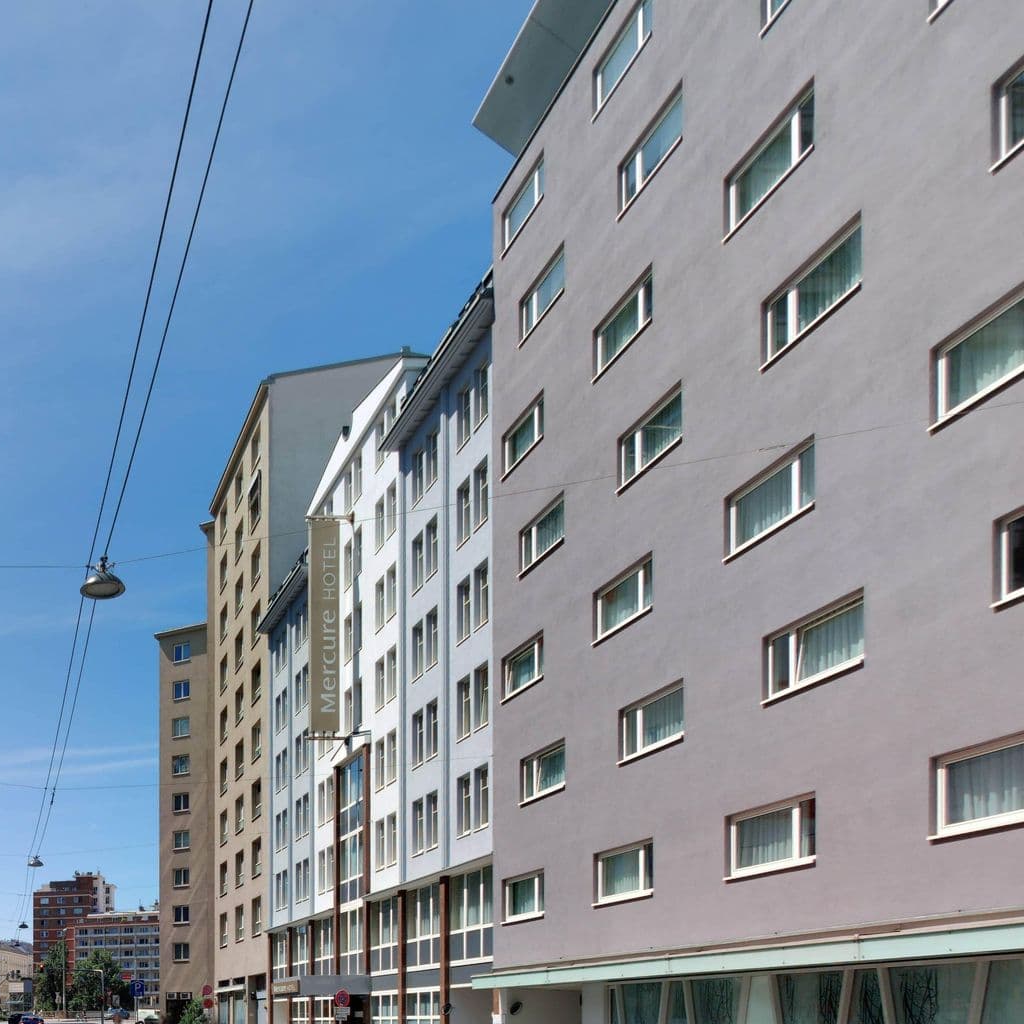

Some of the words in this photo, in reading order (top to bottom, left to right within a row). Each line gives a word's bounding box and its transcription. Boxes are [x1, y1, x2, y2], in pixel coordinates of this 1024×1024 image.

[323, 536, 337, 600] HOTEL
[320, 609, 337, 713] Mercure
[134, 983, 141, 993] P
